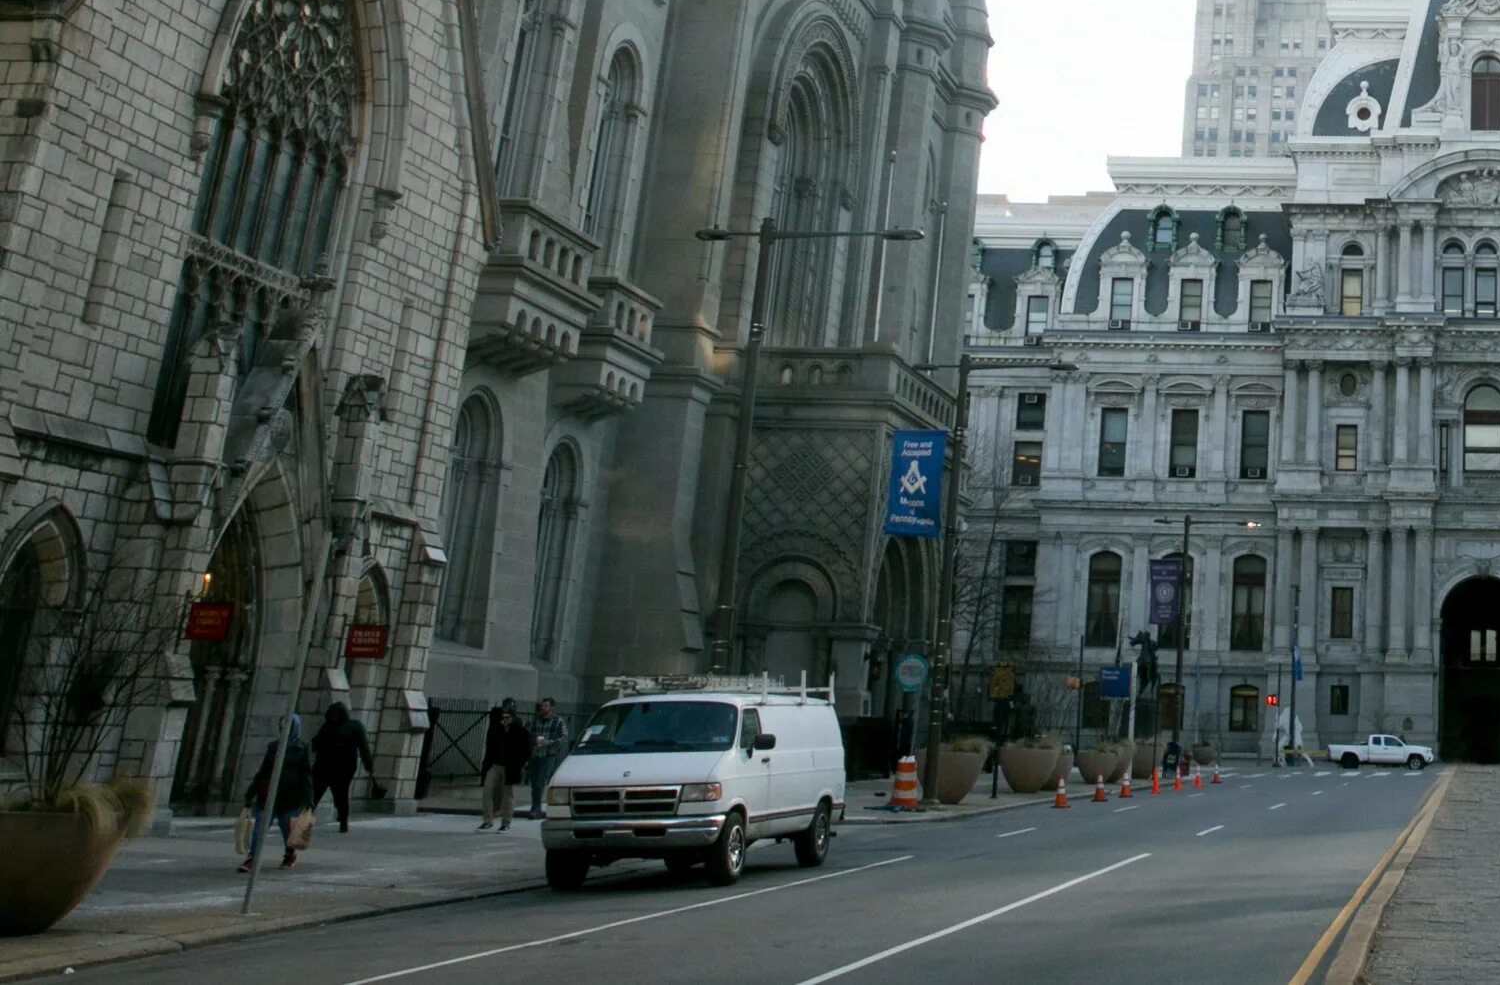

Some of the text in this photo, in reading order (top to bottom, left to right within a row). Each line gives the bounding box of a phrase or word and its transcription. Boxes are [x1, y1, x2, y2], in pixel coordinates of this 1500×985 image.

[903, 440, 919, 448] Free
[901, 449, 932, 457] Accepted
[900, 497, 925, 507] Masons
